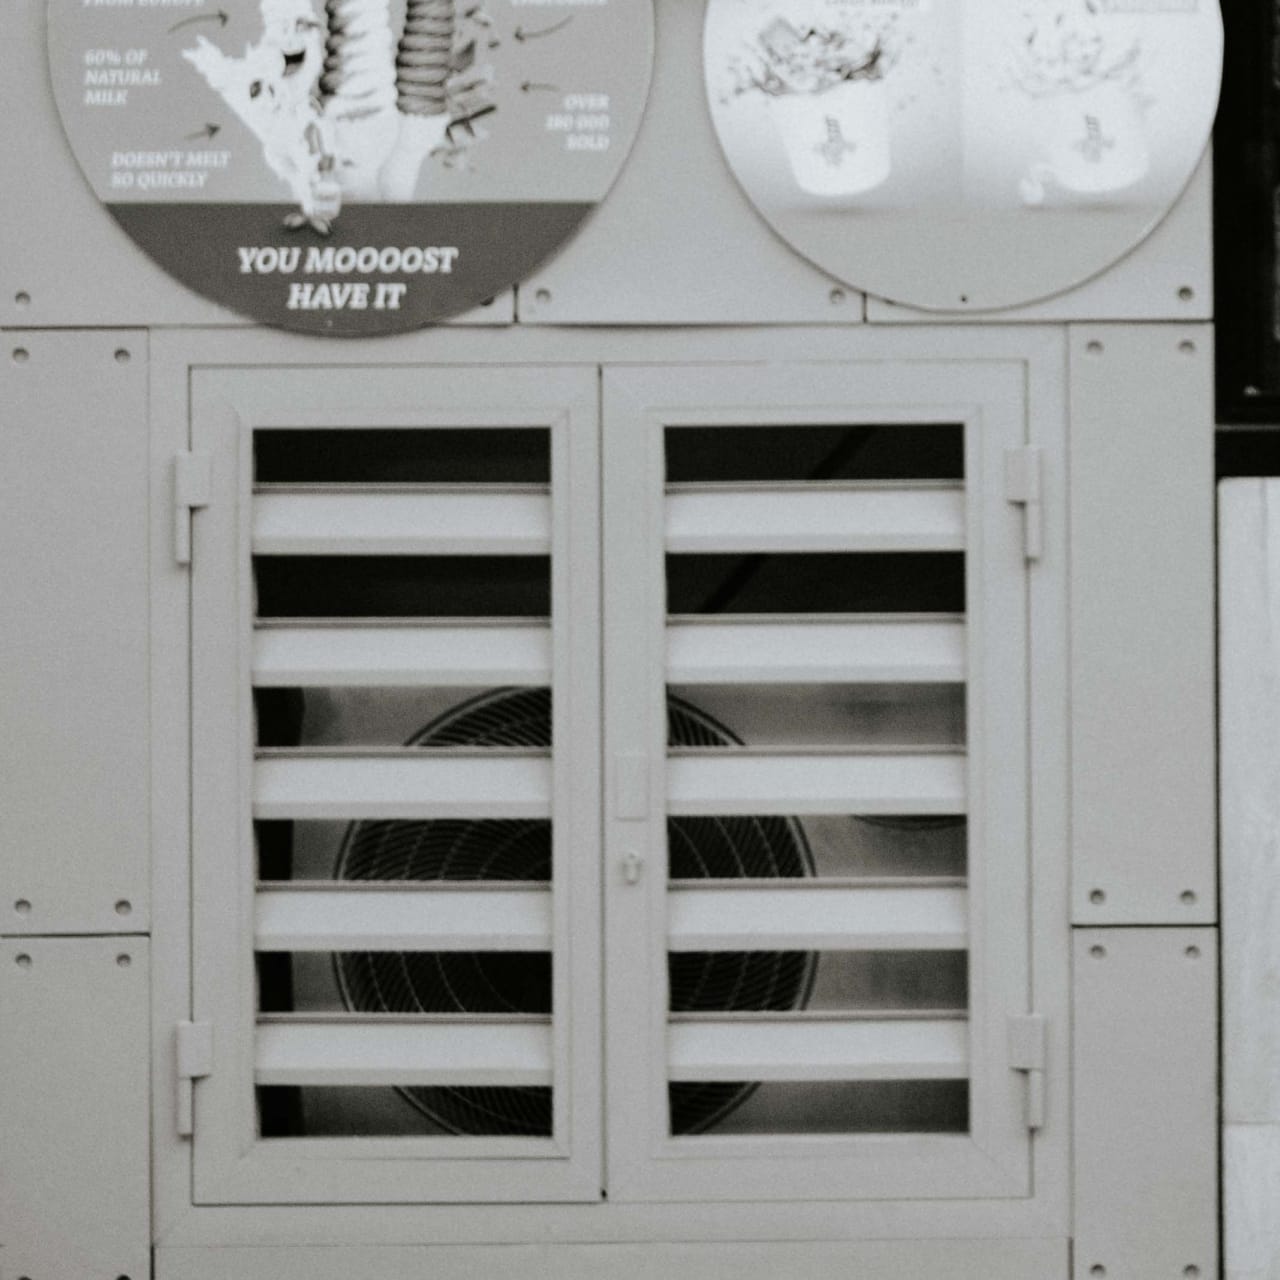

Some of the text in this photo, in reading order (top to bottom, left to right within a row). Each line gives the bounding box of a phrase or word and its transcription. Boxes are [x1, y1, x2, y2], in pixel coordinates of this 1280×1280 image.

[124, 49, 148, 65] OF
[85, 70, 161, 86] NATURAL
[85, 89, 128, 105] MILK
[185, 151, 231, 168] MELT
[111, 172, 208, 190] SO QUICKLY
[238, 246, 459, 273] YOU MOOOOST
[287, 282, 407, 309] HAVE IT
